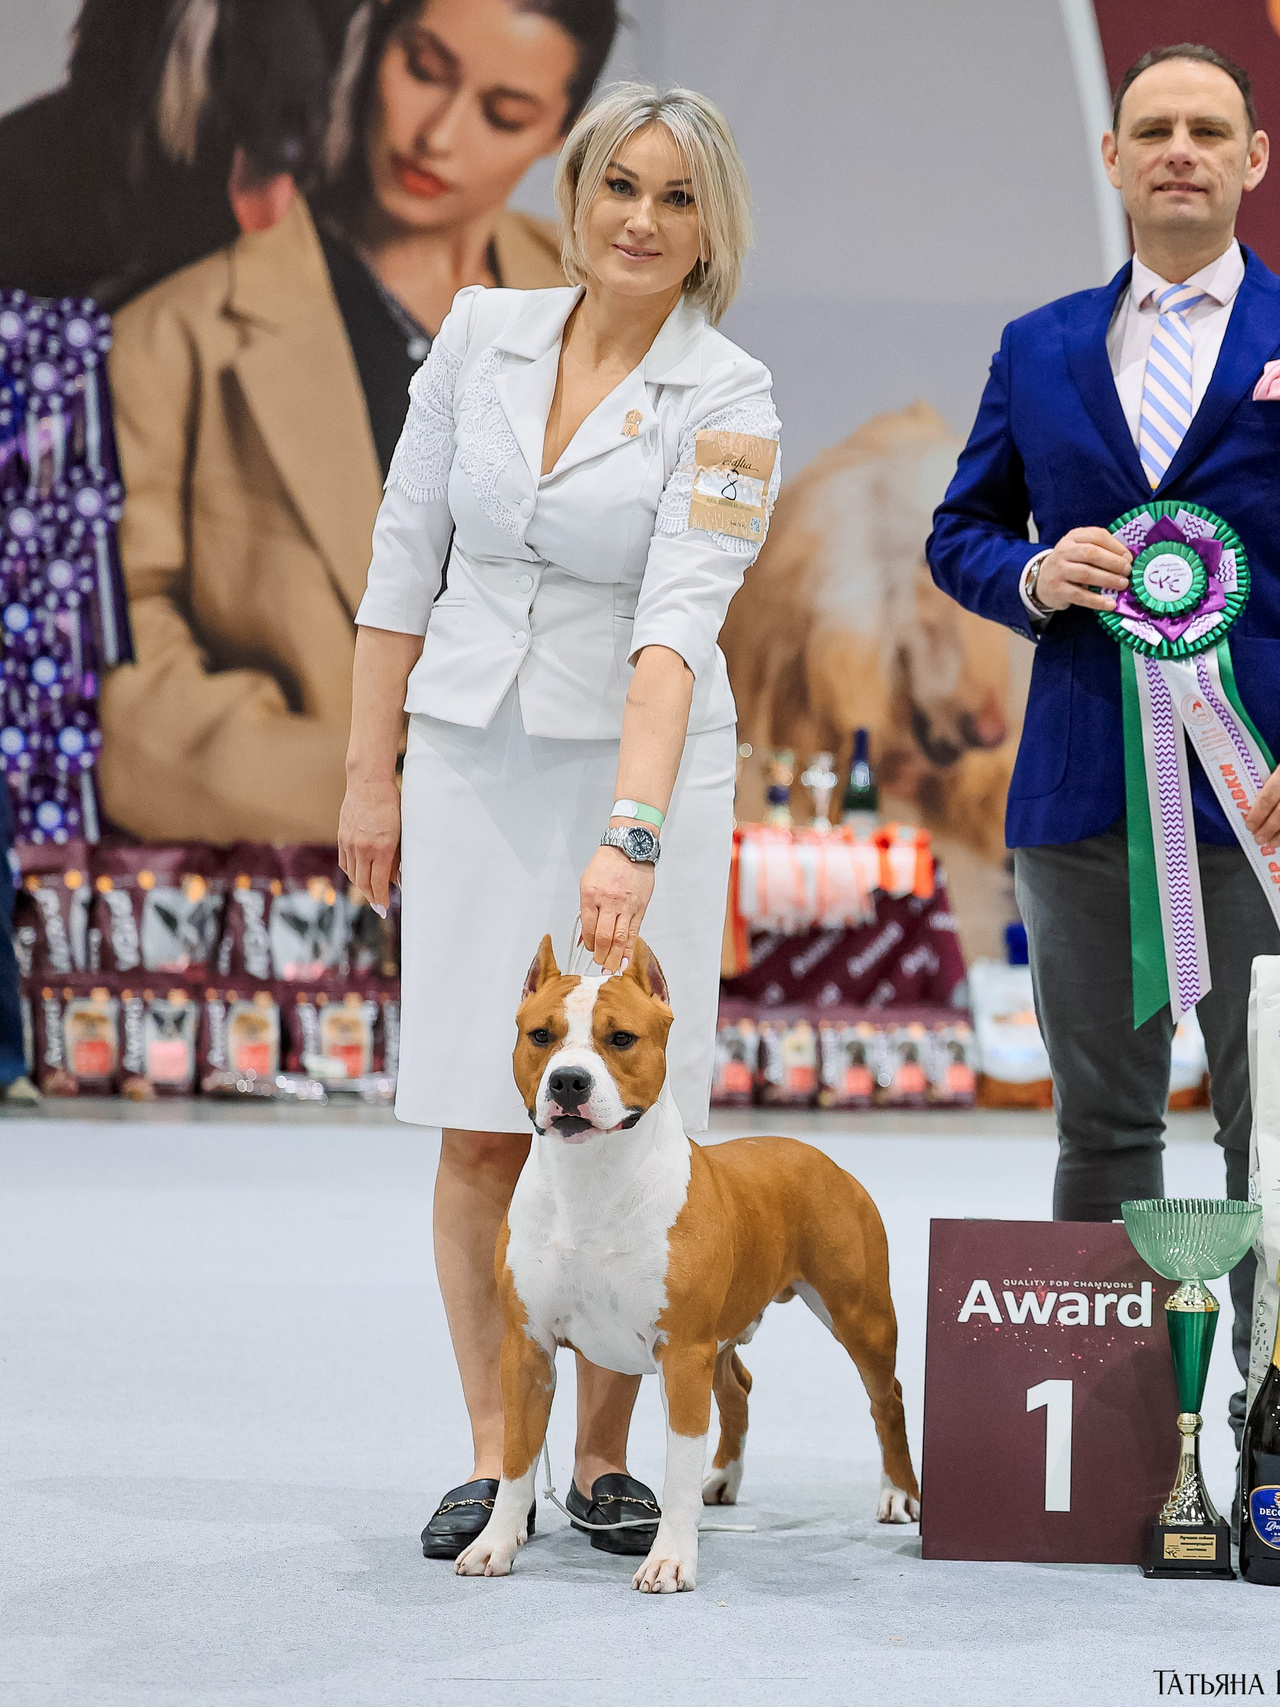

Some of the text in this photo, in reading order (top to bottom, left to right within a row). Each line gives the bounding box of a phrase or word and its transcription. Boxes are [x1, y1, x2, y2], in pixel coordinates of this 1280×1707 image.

[721, 469, 739, 501] 8
[956, 1279, 1153, 1328] Award
[1002, 1278, 1135, 1289] QUALITY FOR CHAMPIONS
[1026, 1379, 1073, 1512] 1
